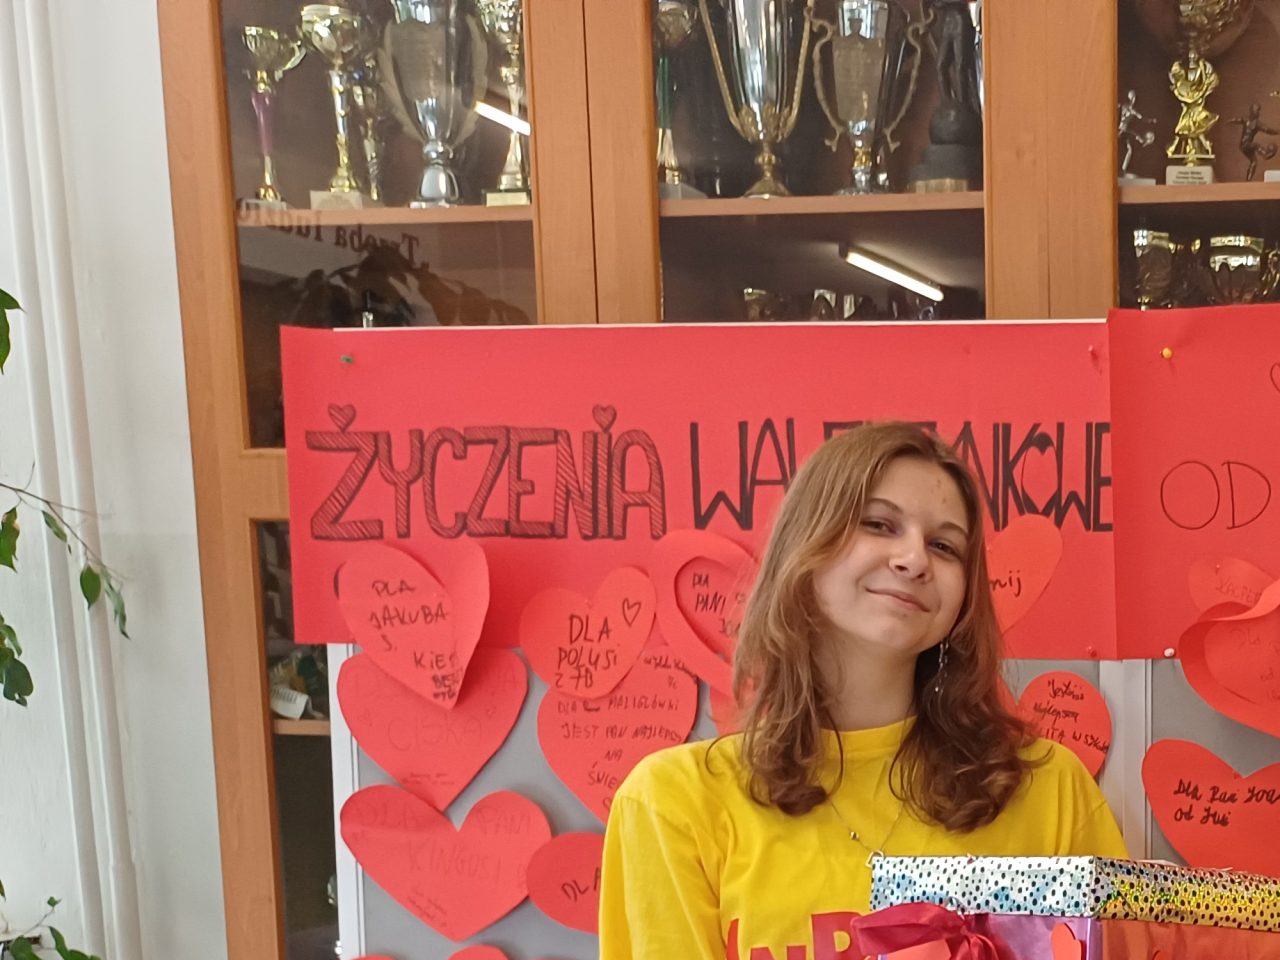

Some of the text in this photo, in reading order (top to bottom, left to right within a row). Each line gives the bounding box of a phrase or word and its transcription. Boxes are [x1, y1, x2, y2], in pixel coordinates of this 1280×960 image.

[305, 403, 667, 540] ŻYCZENIA
[1160, 460, 1271, 529] OD
[568, 613, 612, 645] DLA
